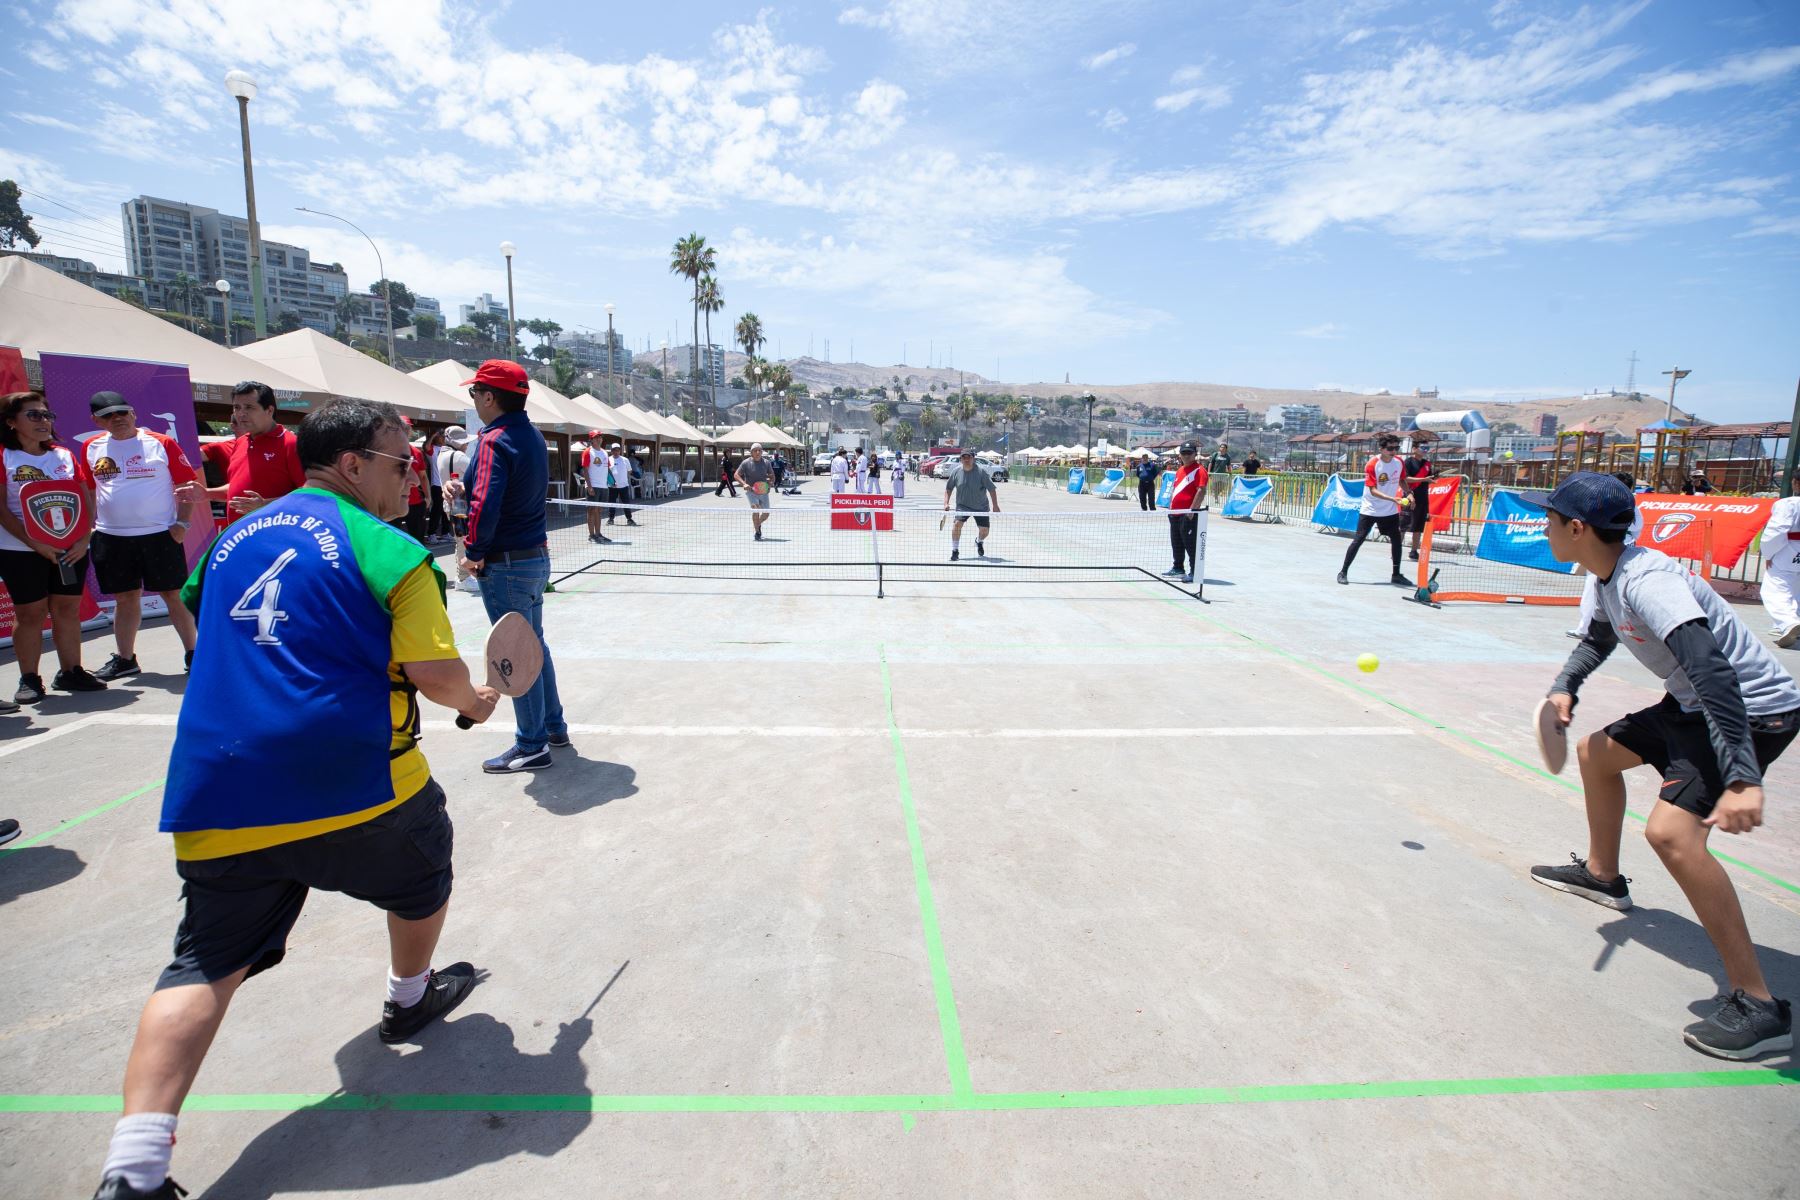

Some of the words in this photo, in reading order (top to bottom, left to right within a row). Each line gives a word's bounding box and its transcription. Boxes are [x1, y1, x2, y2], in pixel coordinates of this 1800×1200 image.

[33, 495, 75, 506] PICKLEBALL
[834, 498, 872, 506] PICKLEBALL
[873, 498, 890, 506] PERÚ
[1638, 501, 1712, 512] PICKLEBALL
[1713, 503, 1759, 514] PERÚ
[229, 548, 298, 646] 4
